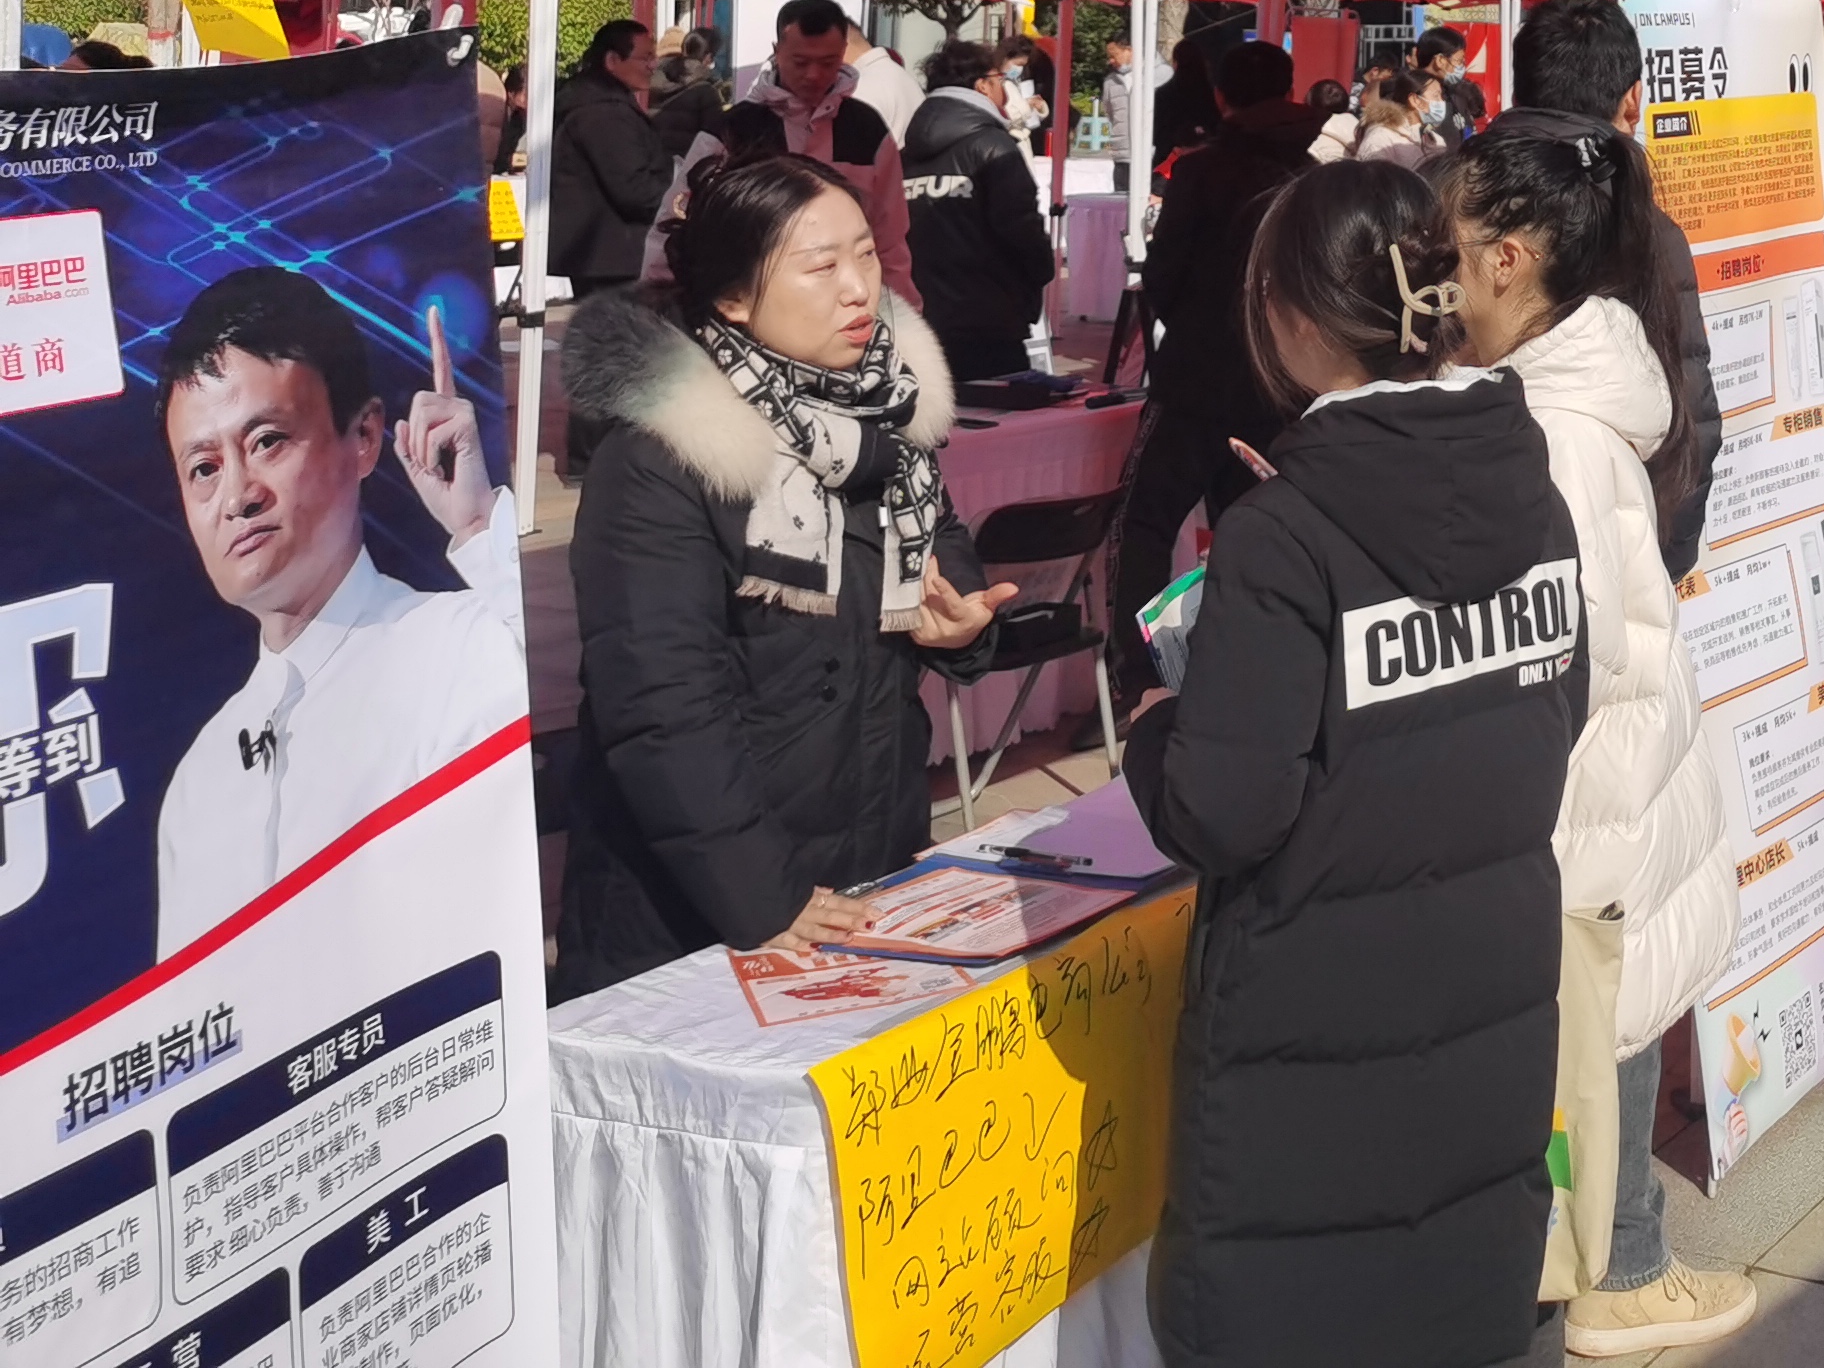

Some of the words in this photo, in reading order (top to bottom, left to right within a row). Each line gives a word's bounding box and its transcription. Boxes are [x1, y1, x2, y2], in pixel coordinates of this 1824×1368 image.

[1645, 46, 1729, 104] 招募令
[1, 155, 92, 178] COMMERCE
[128, 151, 158, 168] LTD
[6, 286, 90, 306] Alibaba.com
[1719, 254, 1762, 280] 招聘岗位
[1783, 407, 1823, 434] 专柜销售
[1365, 576, 1573, 687] CONTROL
[1518, 659, 1553, 687] ONLY
[0, 714, 103, 799] 等到
[62, 1001, 238, 1133] 招聘岗位
[286, 1012, 387, 1097] 客服专员
[366, 1185, 430, 1256] 美工
